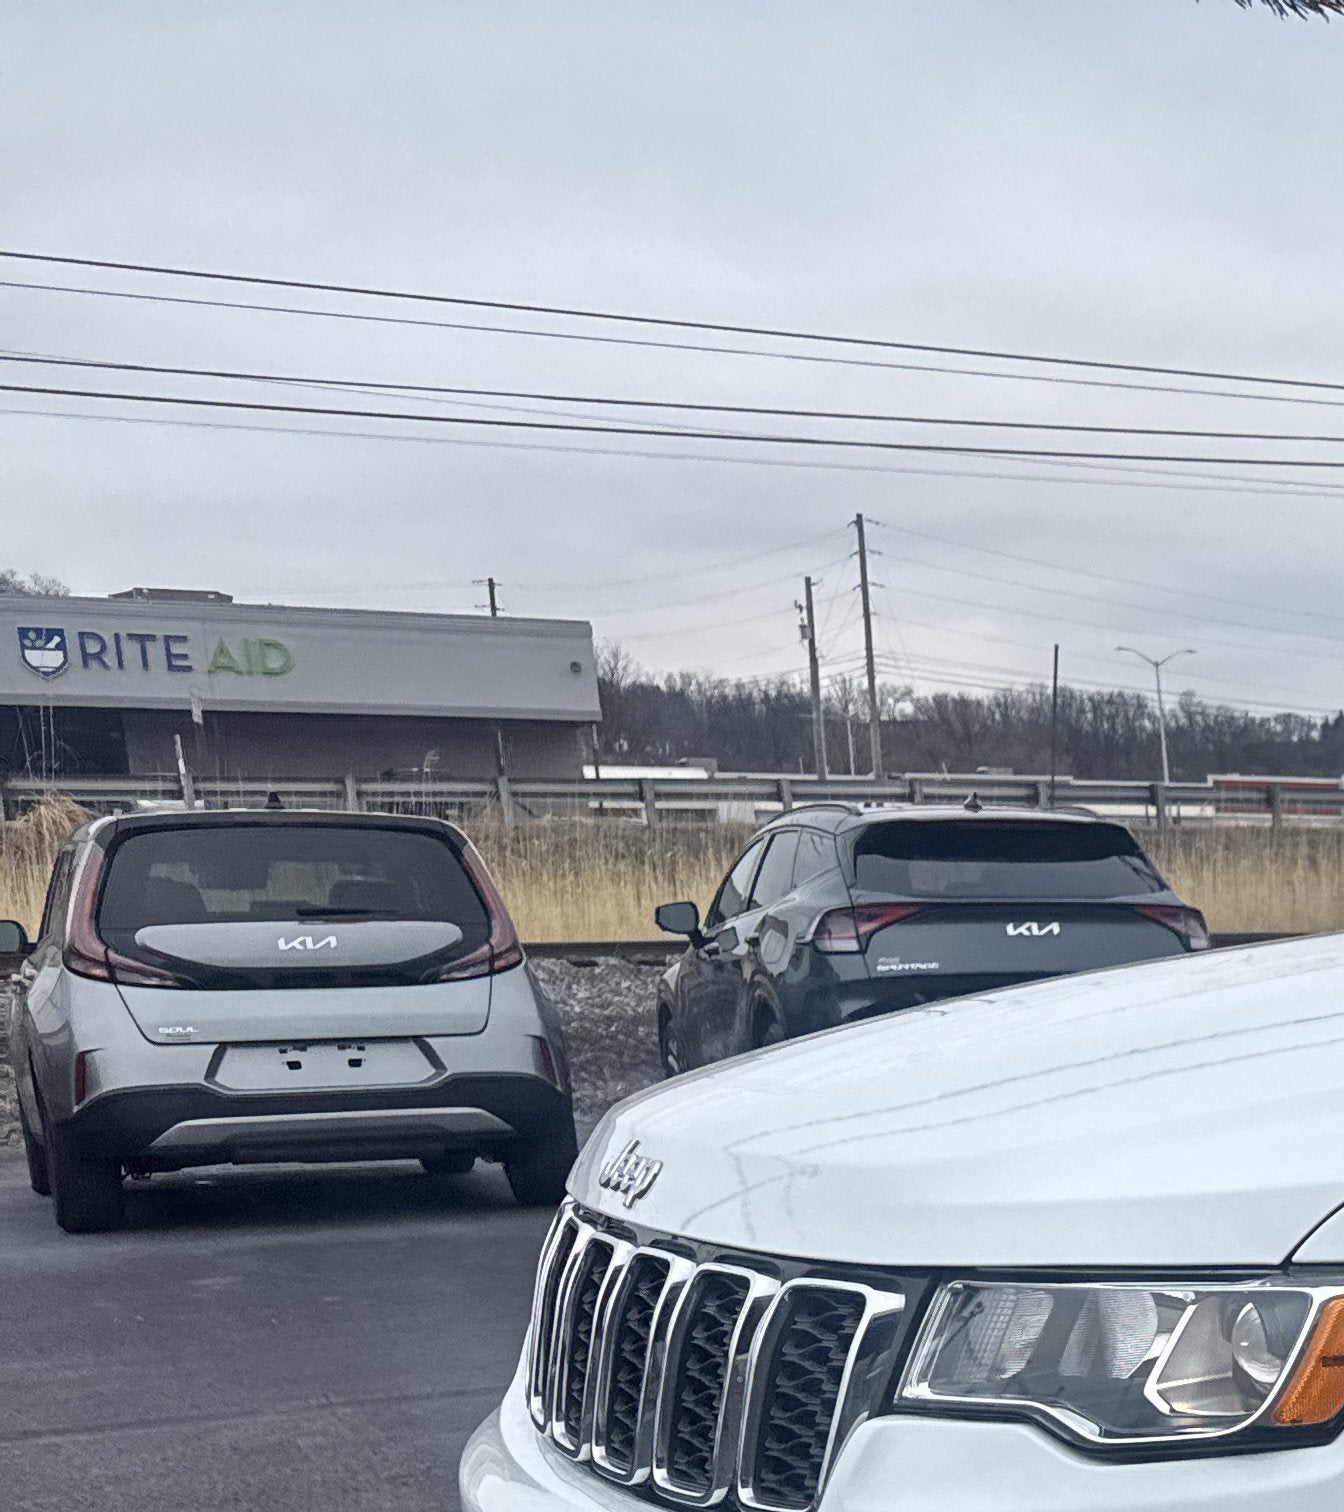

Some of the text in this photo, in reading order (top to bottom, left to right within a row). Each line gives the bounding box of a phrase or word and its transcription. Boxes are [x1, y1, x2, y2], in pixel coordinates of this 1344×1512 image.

[78, 631, 296, 677] RITE AID
[278, 935, 337, 950] KIA
[1006, 921, 1061, 936] KIA
[599, 1139, 663, 1209] Jeep
